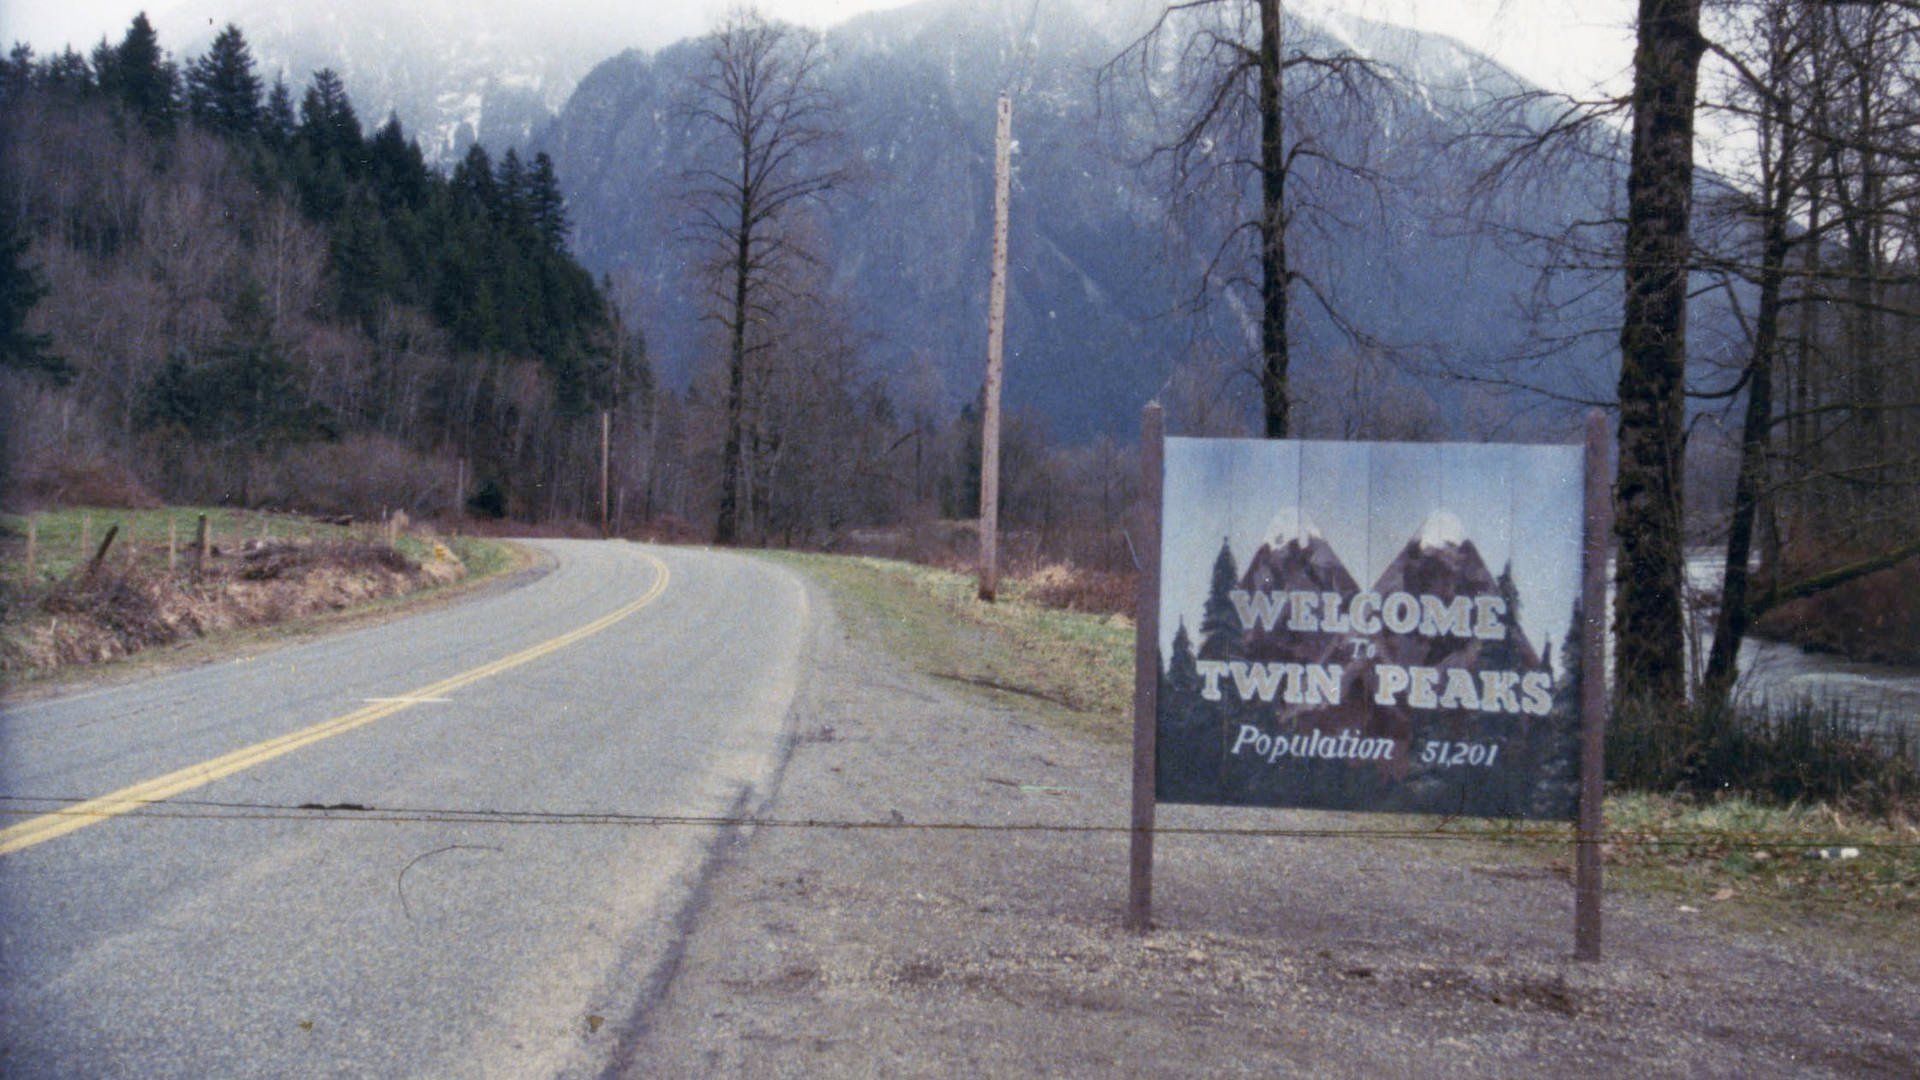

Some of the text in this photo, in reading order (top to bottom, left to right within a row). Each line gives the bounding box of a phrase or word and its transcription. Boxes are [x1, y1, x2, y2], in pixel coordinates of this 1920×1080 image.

[1231, 591, 1506, 638] WELCOME
[1197, 660, 1553, 715] TWIN PEAKS
[1231, 725, 1499, 768] Population 51,201
